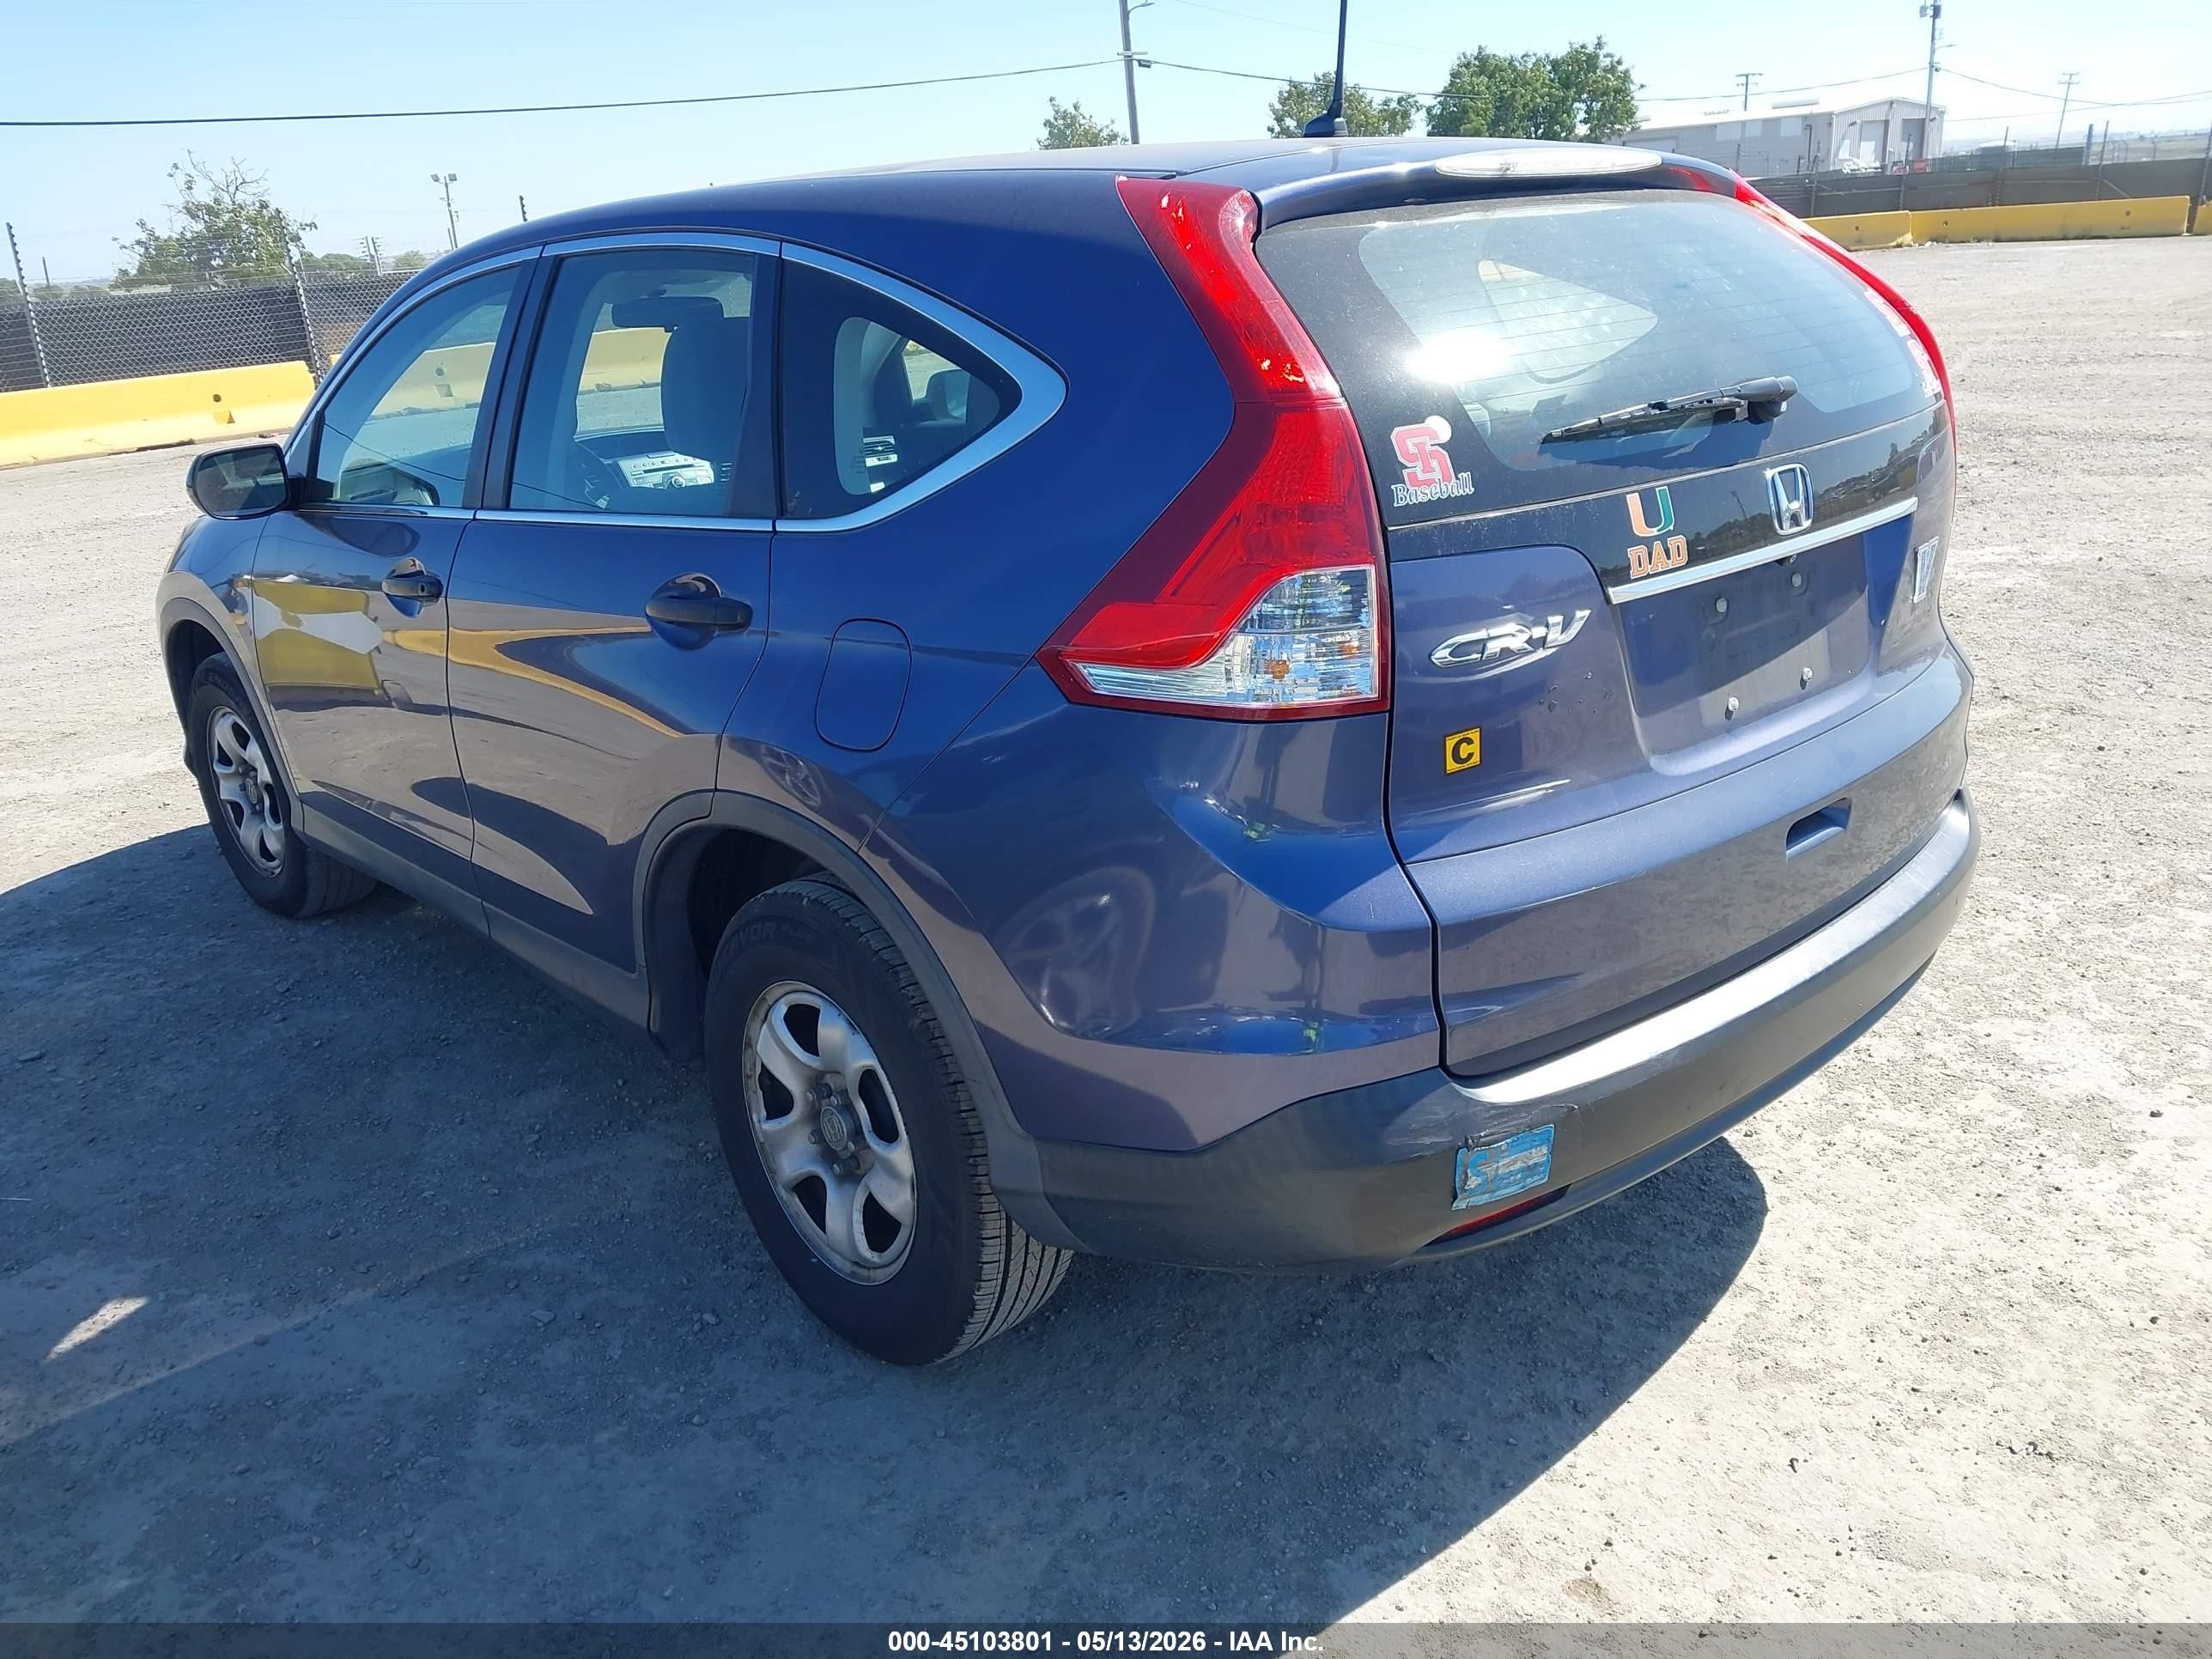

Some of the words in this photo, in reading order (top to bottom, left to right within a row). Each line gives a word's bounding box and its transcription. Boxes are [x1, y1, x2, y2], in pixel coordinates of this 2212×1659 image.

[1391, 471, 1475, 507] Baseball
[1626, 485, 1675, 538] U
[1627, 535, 1689, 580] DAD
[1429, 609, 1593, 668] CR-V
[1451, 736, 1475, 765] C
